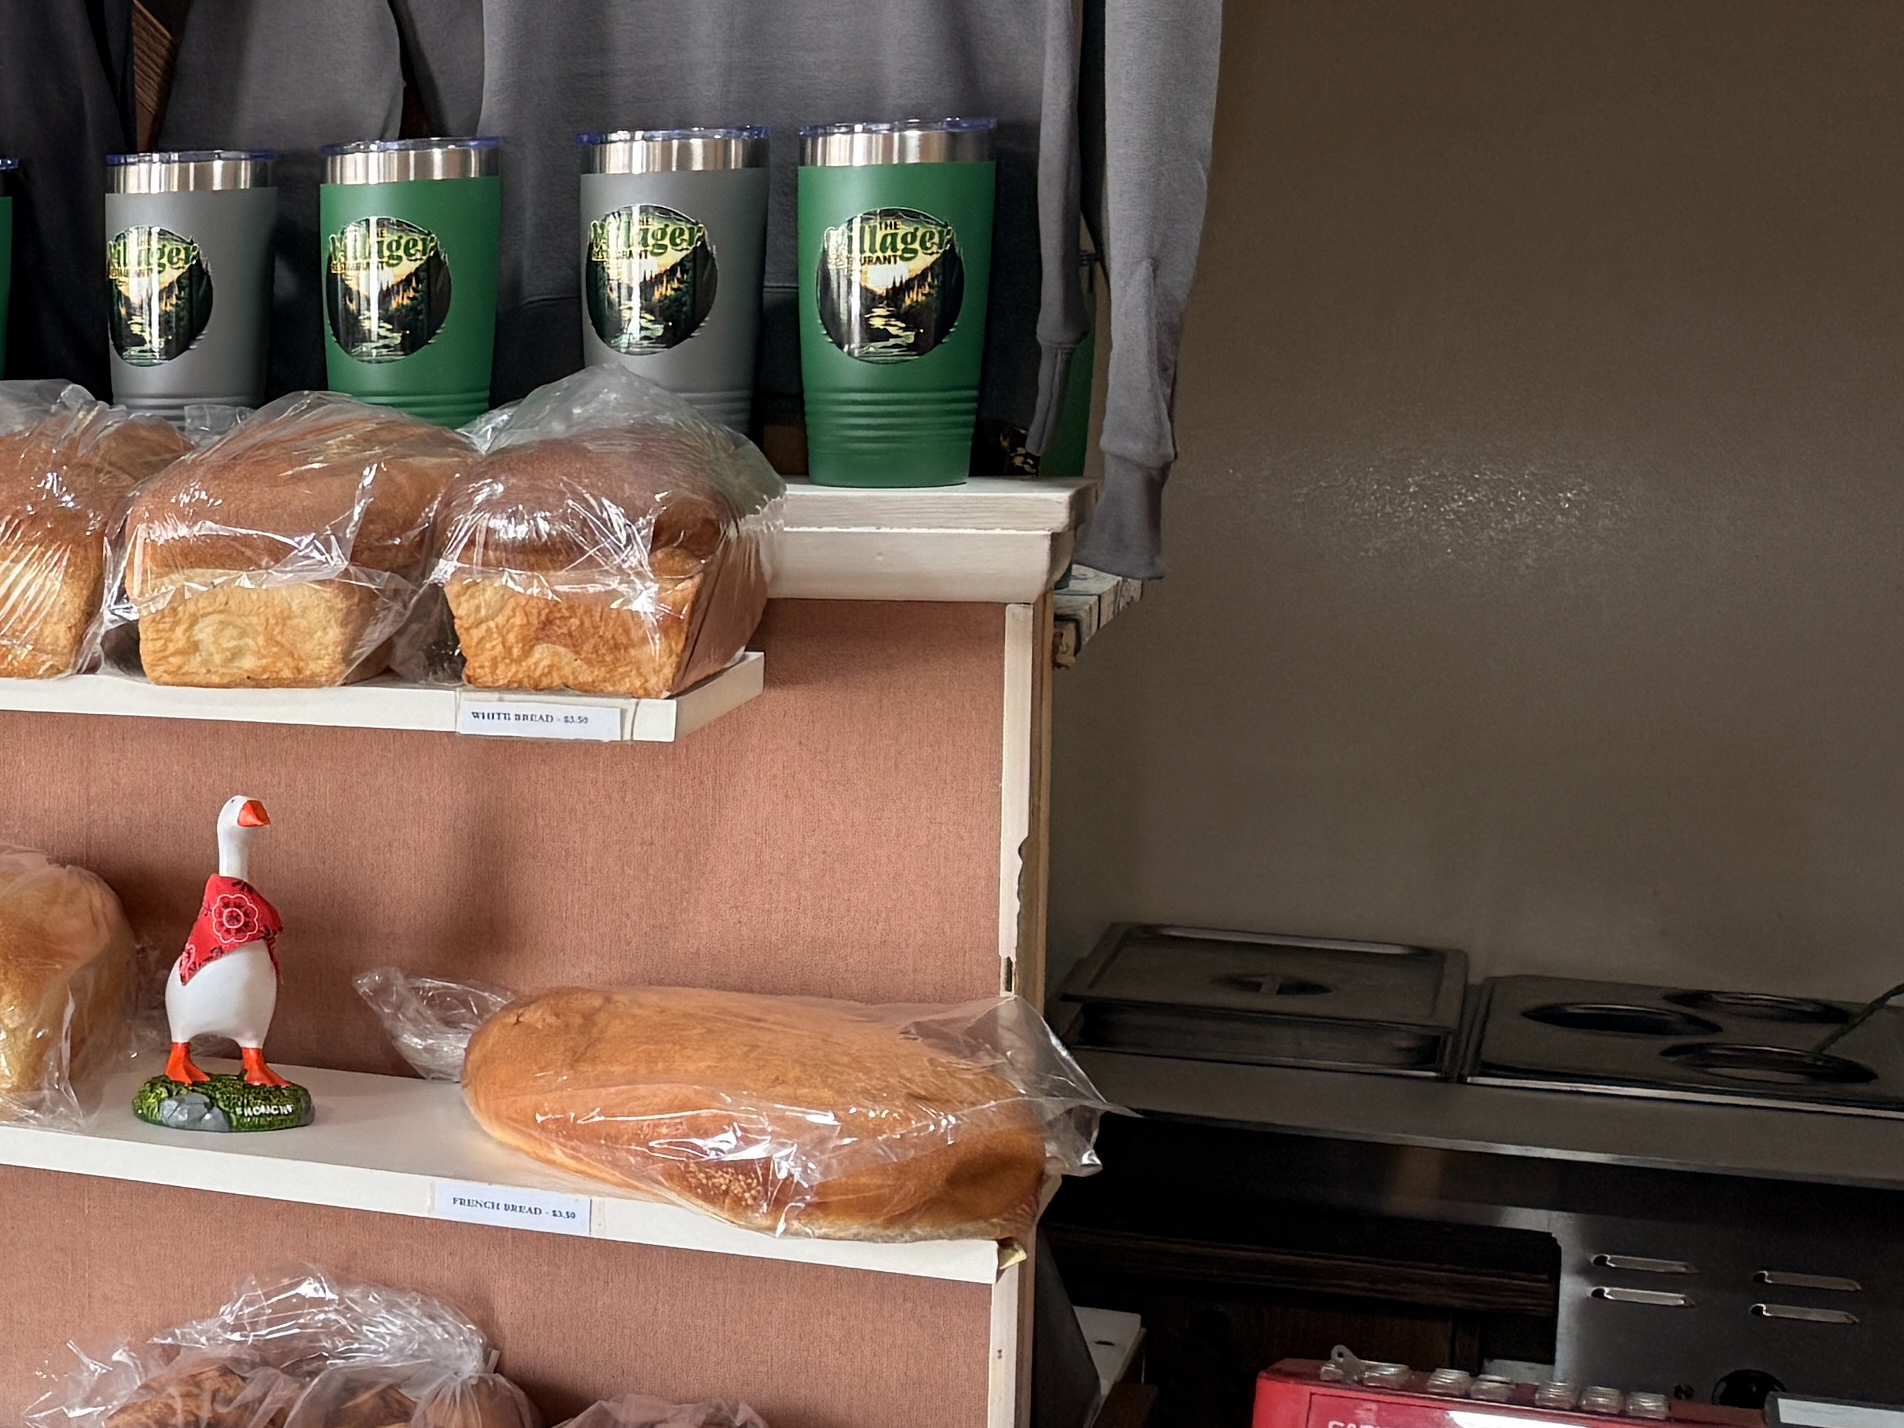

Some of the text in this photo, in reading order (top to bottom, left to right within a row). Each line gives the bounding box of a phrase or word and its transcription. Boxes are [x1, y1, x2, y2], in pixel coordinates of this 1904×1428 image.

[471, 711, 511, 721] WHITE
[514, 713, 554, 723] BREAD
[453, 1197, 501, 1211] FRENCH
[504, 1203, 543, 1216] BREAD
